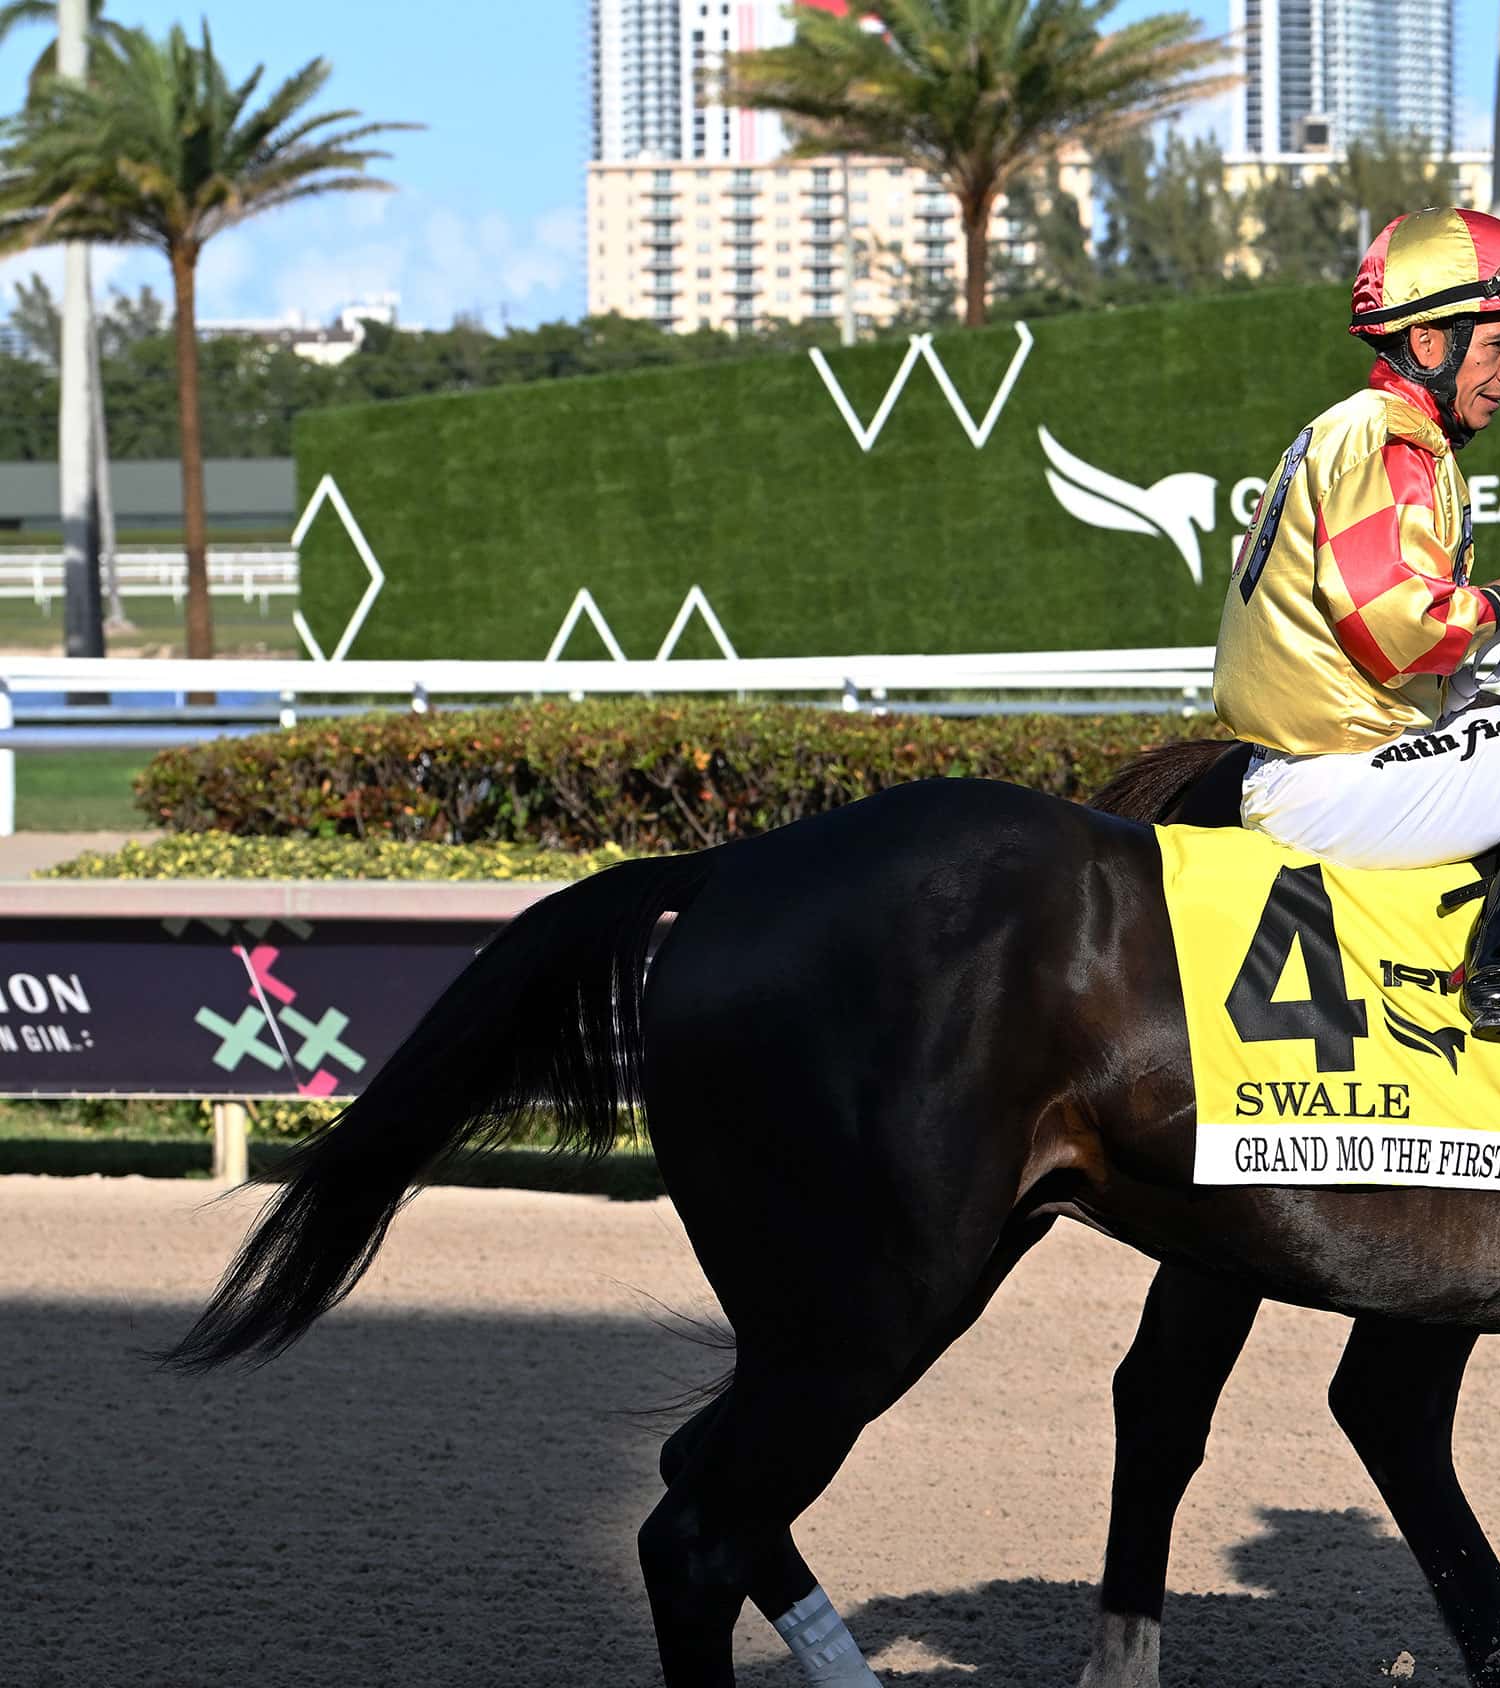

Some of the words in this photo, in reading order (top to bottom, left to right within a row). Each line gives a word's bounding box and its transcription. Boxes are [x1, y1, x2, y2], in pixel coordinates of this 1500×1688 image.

[1225, 863, 1368, 1073] 4
[1236, 1081, 1411, 1119] SWALE
[1235, 1136, 1328, 1173] GRAND
[1336, 1136, 1374, 1173] MO
[1382, 1137, 1430, 1175] THE
